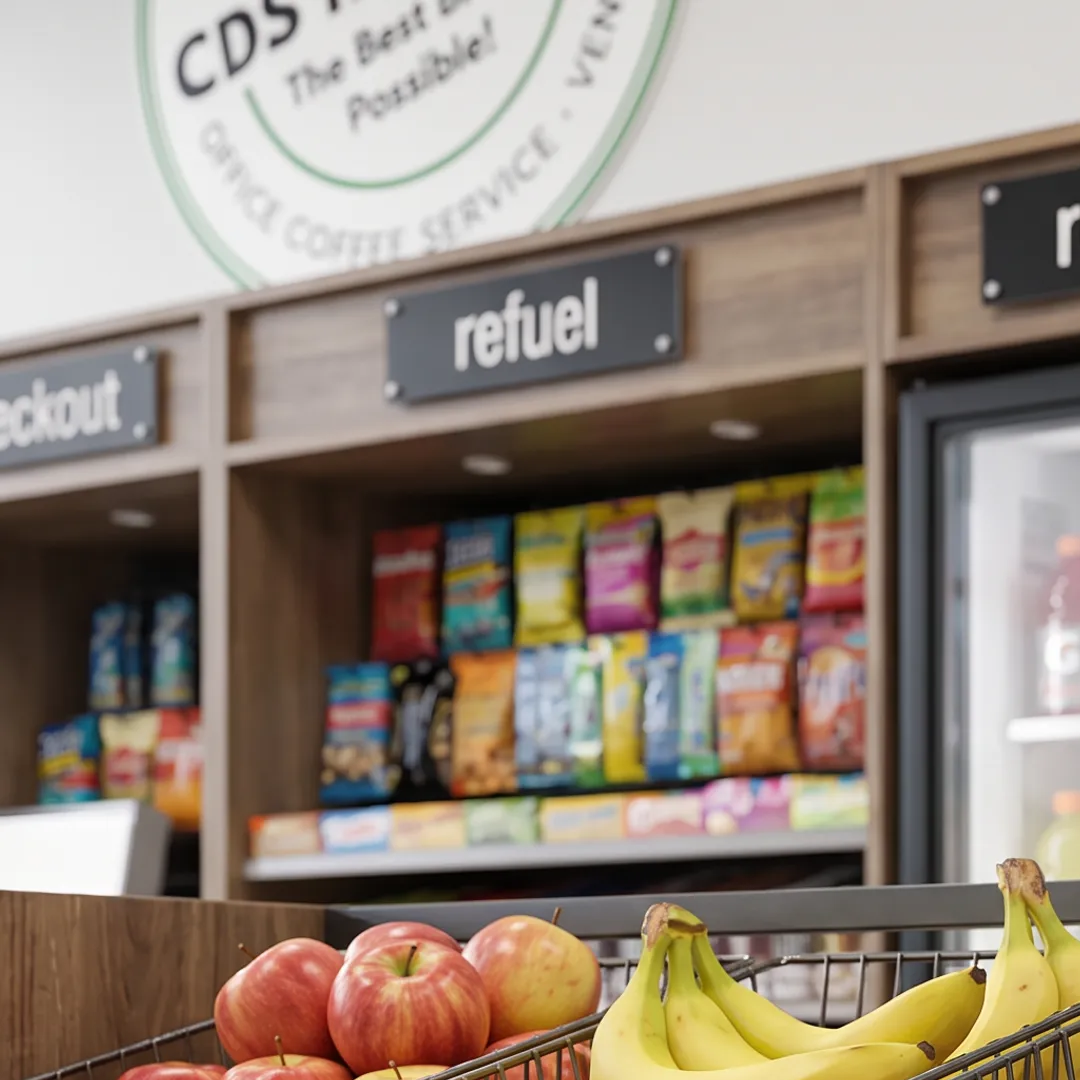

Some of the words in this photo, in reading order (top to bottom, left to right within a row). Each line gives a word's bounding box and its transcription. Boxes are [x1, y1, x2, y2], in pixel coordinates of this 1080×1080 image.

[178, 0, 298, 97] CDS
[287, 58, 345, 106] The
[353, 2, 427, 66] Best
[419, 123, 561, 257] SERVICE
[454, 276, 599, 372] refuel
